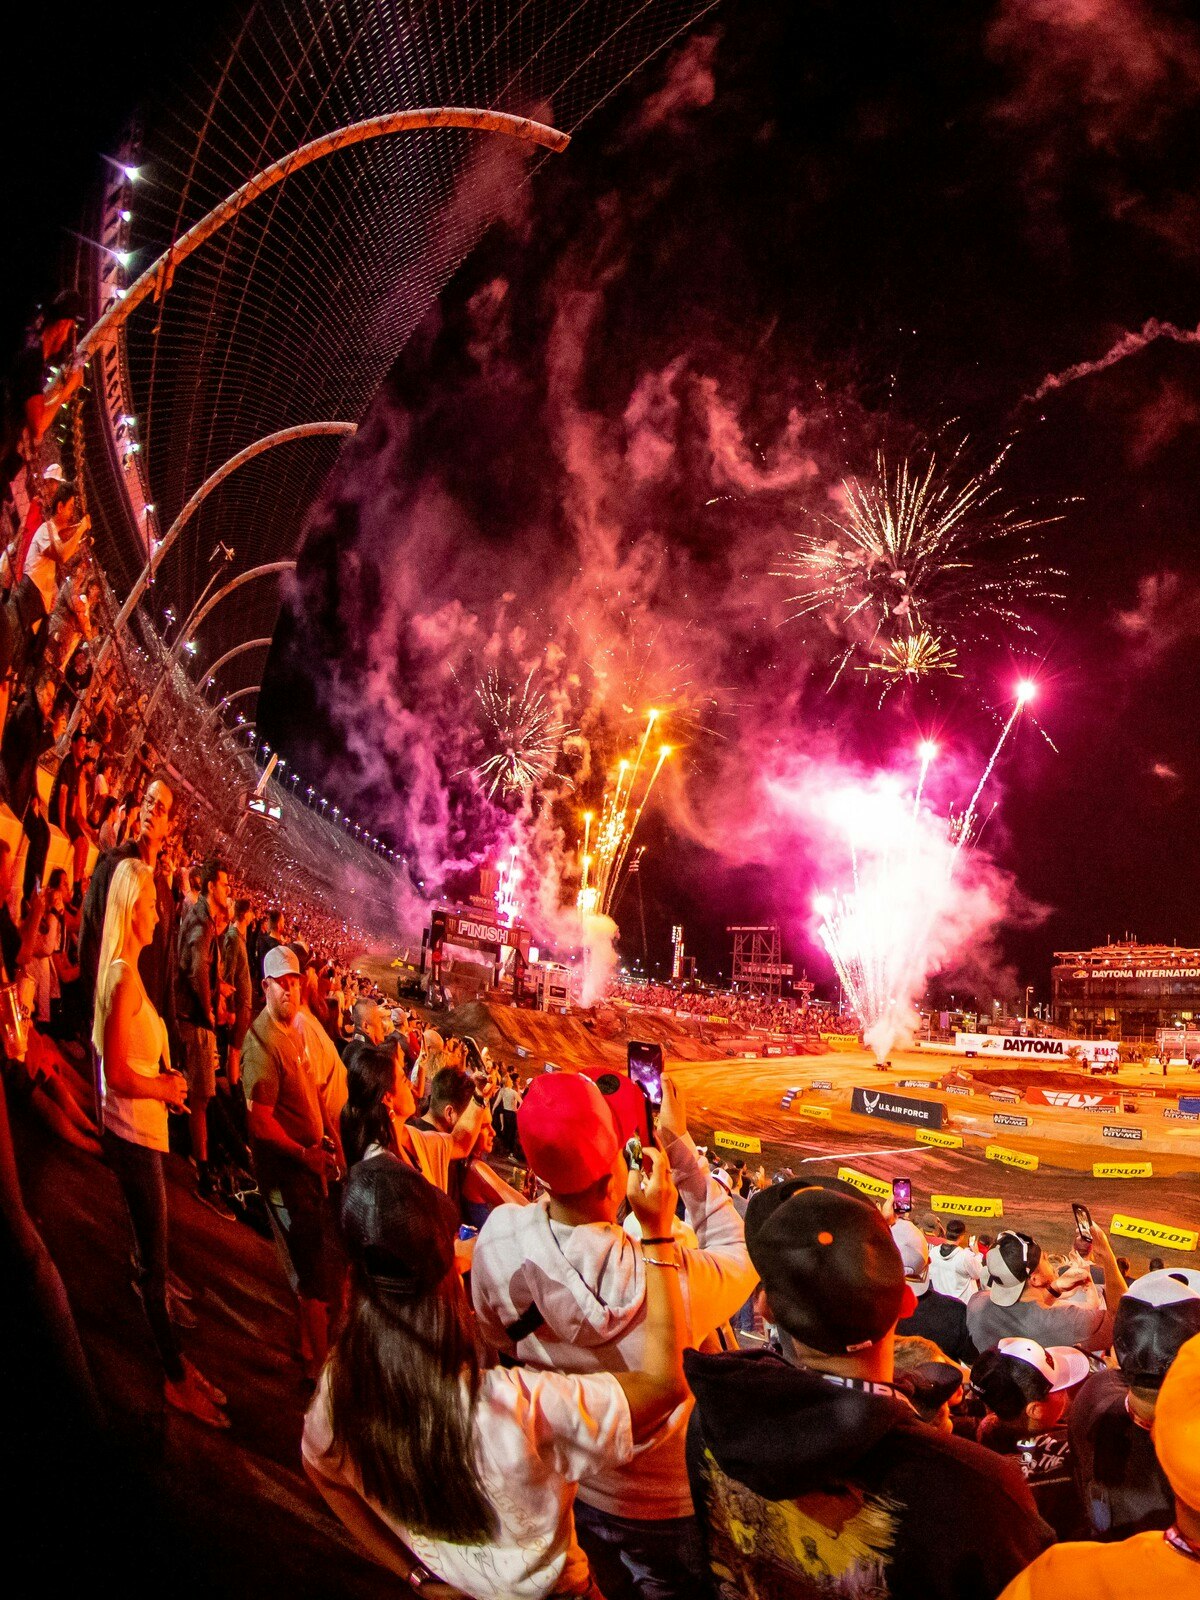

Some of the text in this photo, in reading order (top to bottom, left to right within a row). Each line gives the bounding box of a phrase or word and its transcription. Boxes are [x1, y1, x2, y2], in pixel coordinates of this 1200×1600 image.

[458, 919, 509, 944] FINISH
[1092, 969, 1133, 978] DAYTONA
[1002, 1039, 1064, 1055] DAYTONA
[1041, 1090, 1104, 1108] FLY
[878, 1103, 929, 1119] U.S. AIR FORCE
[719, 1138, 750, 1149] DUNLOP
[922, 1135, 956, 1147] DUNLOP
[994, 1152, 1032, 1166] DUNLOP
[1101, 1167, 1146, 1176] DUNLOP
[846, 1176, 890, 1195] DUNLOP
[941, 1201, 992, 1213] DUNLOP
[1125, 1224, 1192, 1244] DUNLOP
